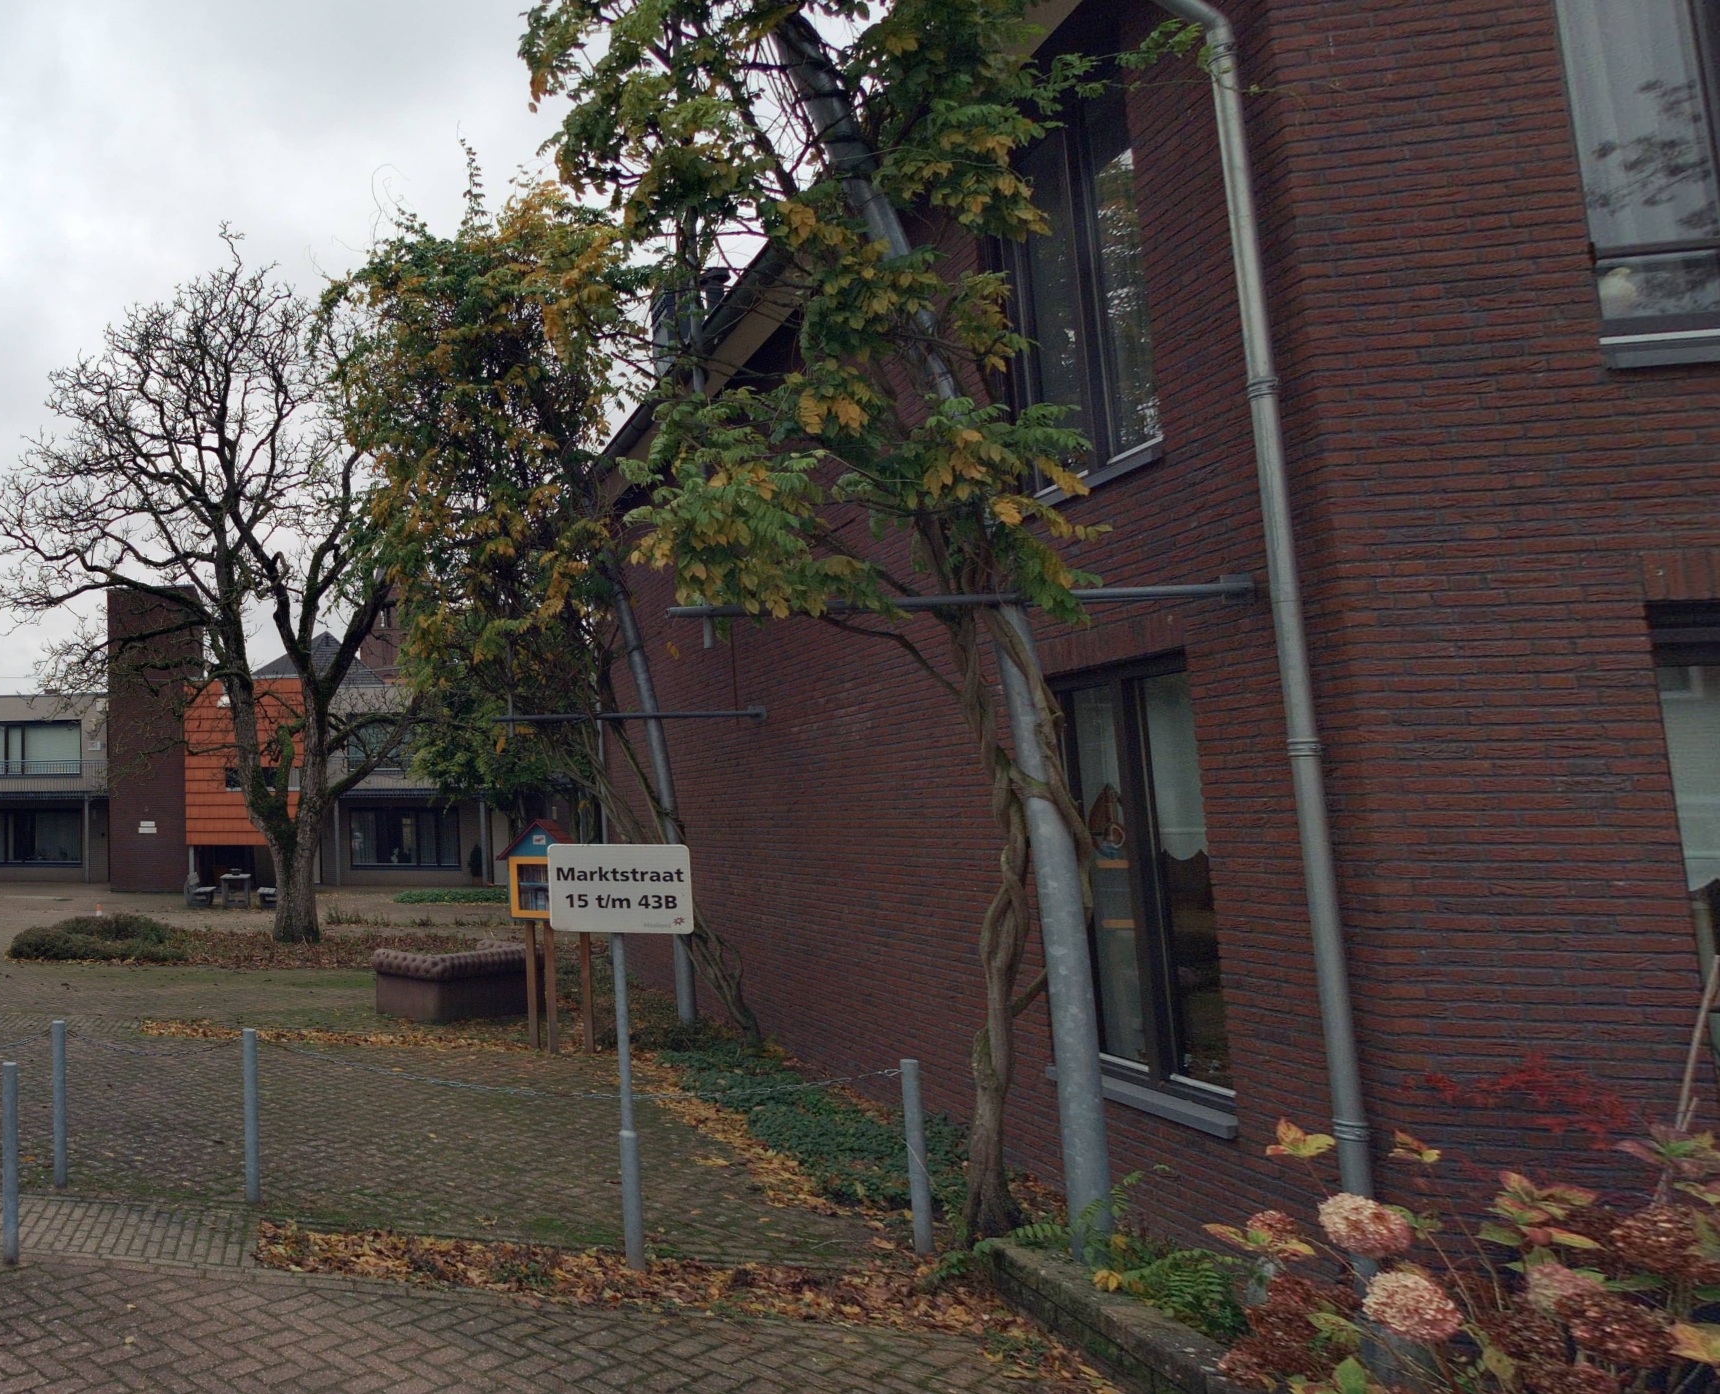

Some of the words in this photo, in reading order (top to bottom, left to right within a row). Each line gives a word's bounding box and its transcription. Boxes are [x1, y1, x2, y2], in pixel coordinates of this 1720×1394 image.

[556, 866, 685, 883] Marktstraat
[565, 893, 589, 909] 15
[595, 894, 631, 909] t/m
[638, 894, 678, 910] 43B
